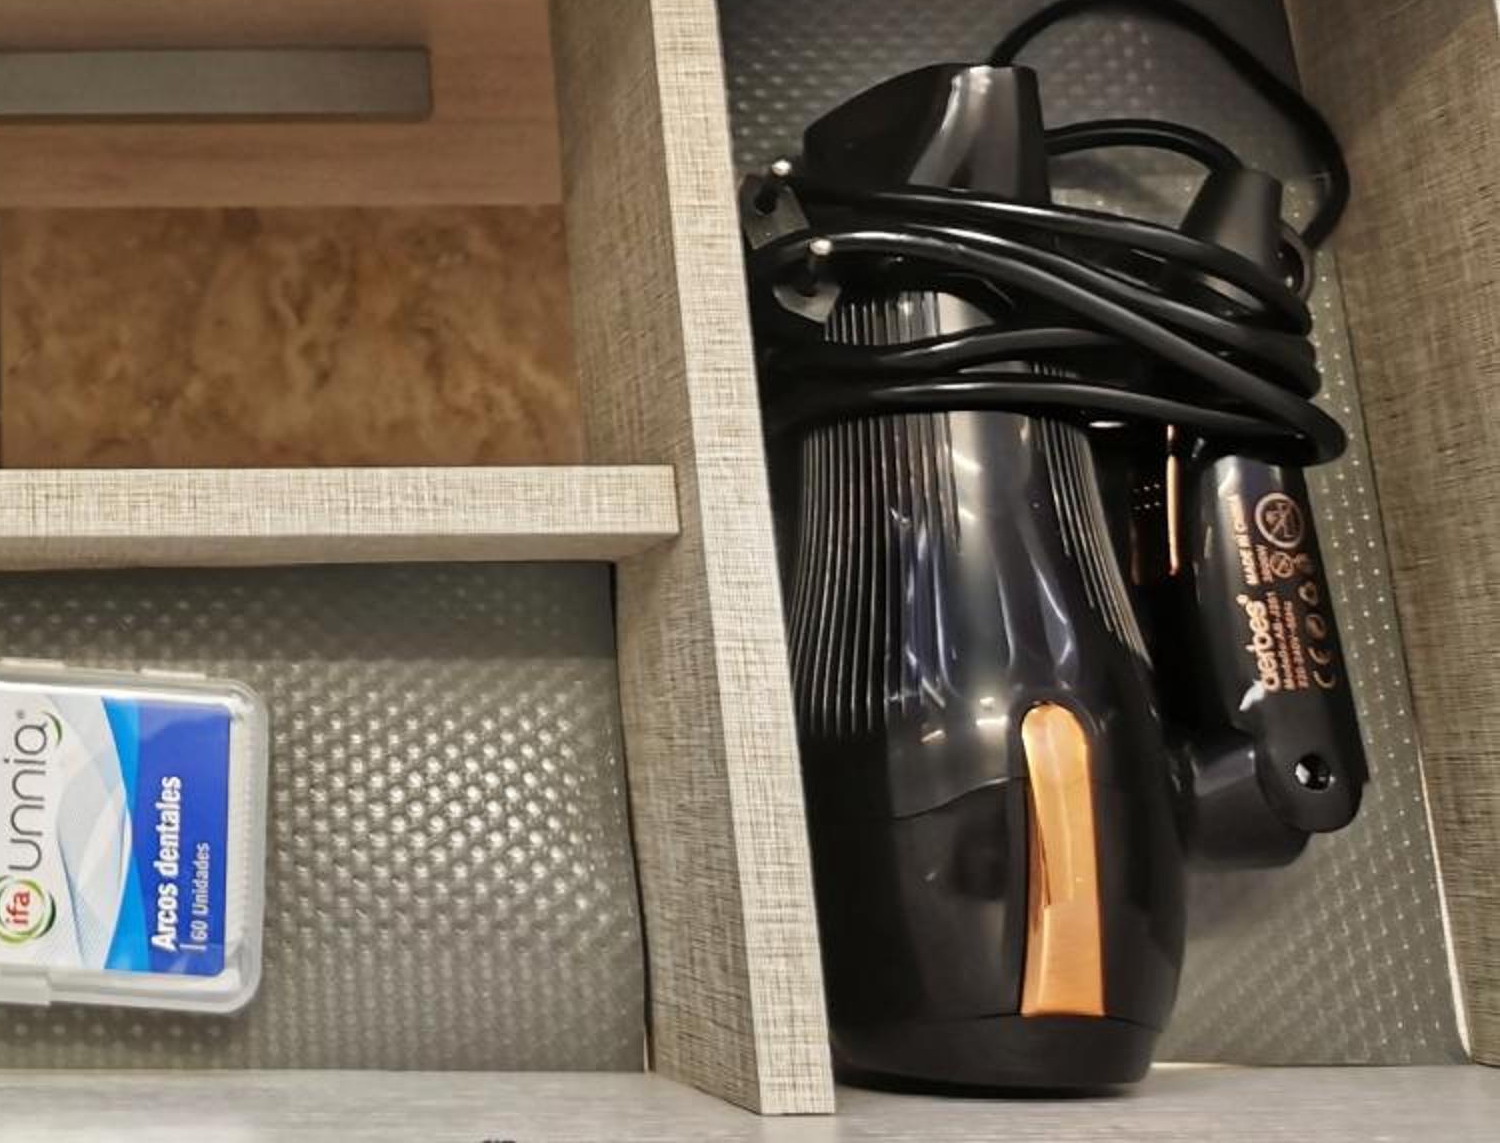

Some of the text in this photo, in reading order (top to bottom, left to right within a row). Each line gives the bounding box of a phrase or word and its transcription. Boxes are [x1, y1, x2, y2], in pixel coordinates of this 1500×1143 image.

[1235, 534, 1251, 548] IN
[1239, 547, 1259, 585] MADE
[151, 776, 182, 952] Arcos dentales
[5, 890, 31, 925] ifa
[190, 842, 211, 943] 60 Unidades
